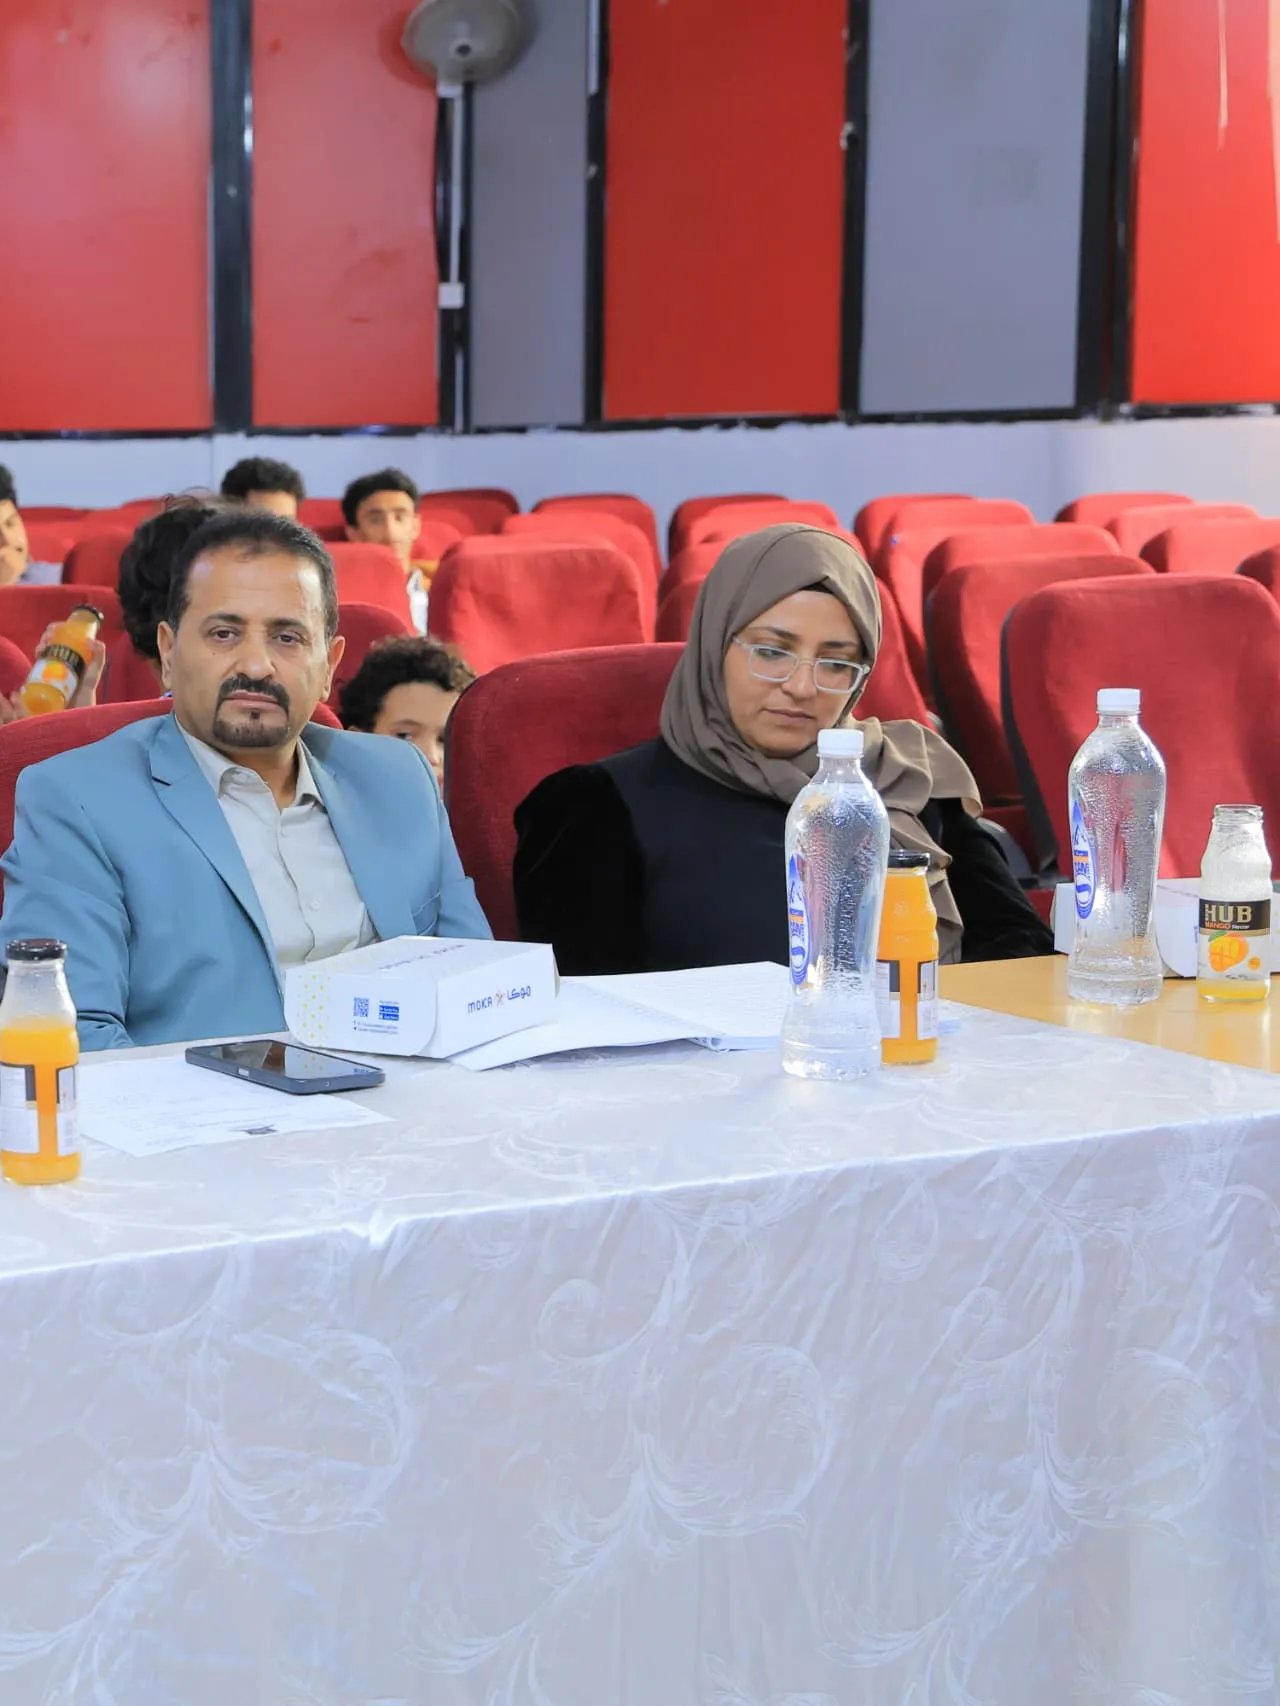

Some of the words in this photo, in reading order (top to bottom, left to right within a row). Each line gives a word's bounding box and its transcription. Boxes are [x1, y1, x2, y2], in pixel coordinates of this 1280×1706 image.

[1204, 903, 1253, 923] HUB
[1204, 921, 1231, 930] MANGO
[467, 995, 493, 1014] MOKA
